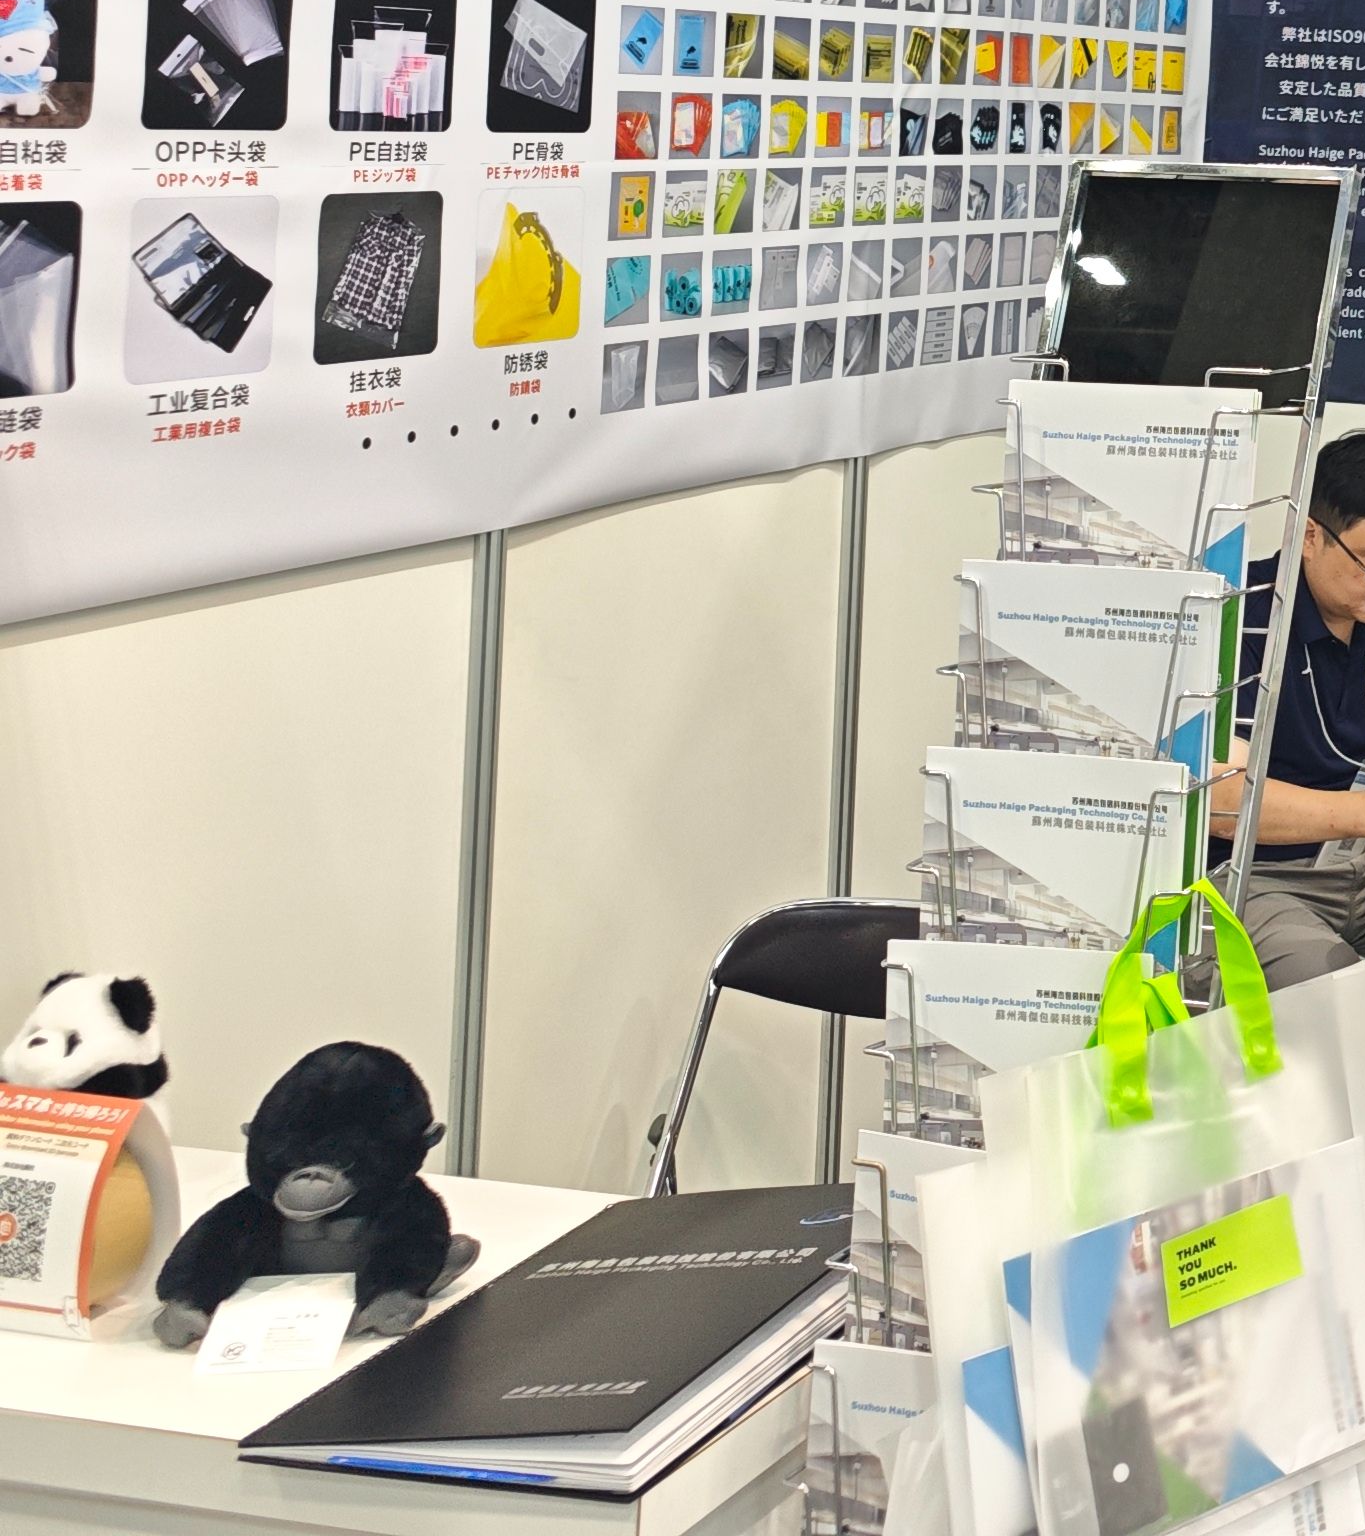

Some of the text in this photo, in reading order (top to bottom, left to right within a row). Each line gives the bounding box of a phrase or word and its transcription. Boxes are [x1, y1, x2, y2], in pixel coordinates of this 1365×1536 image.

[1266, 0, 1286, 15] す。
[155, 140, 267, 164] OPP卡头袋
[349, 141, 428, 162] PE自封袋
[512, 142, 564, 162] PE骨袋
[1258, 145, 1304, 157] Suzhou
[1308, 147, 1344, 161] Haige
[157, 171, 259, 187] OPP ヘッダー袋
[353, 167, 416, 183] PE ジップ袋
[486, 166, 501, 180] PE
[504, 350, 549, 375] 防锈袋
[349, 367, 402, 393] 挂衣袋
[147, 384, 251, 416] 工业复合袋
[345, 398, 405, 418] 衣類カバー
[151, 417, 241, 442] 工業用複合袋
[1042, 430, 1202, 447] Suzhou Haige Packaging Technology
[0, 442, 36, 462] ク袋
[1176, 1236, 1216, 1261] THANK
[1178, 1258, 1202, 1275] YOU
[1179, 1275, 1196, 1291] SO
[1198, 1261, 1238, 1284] MUCH.
